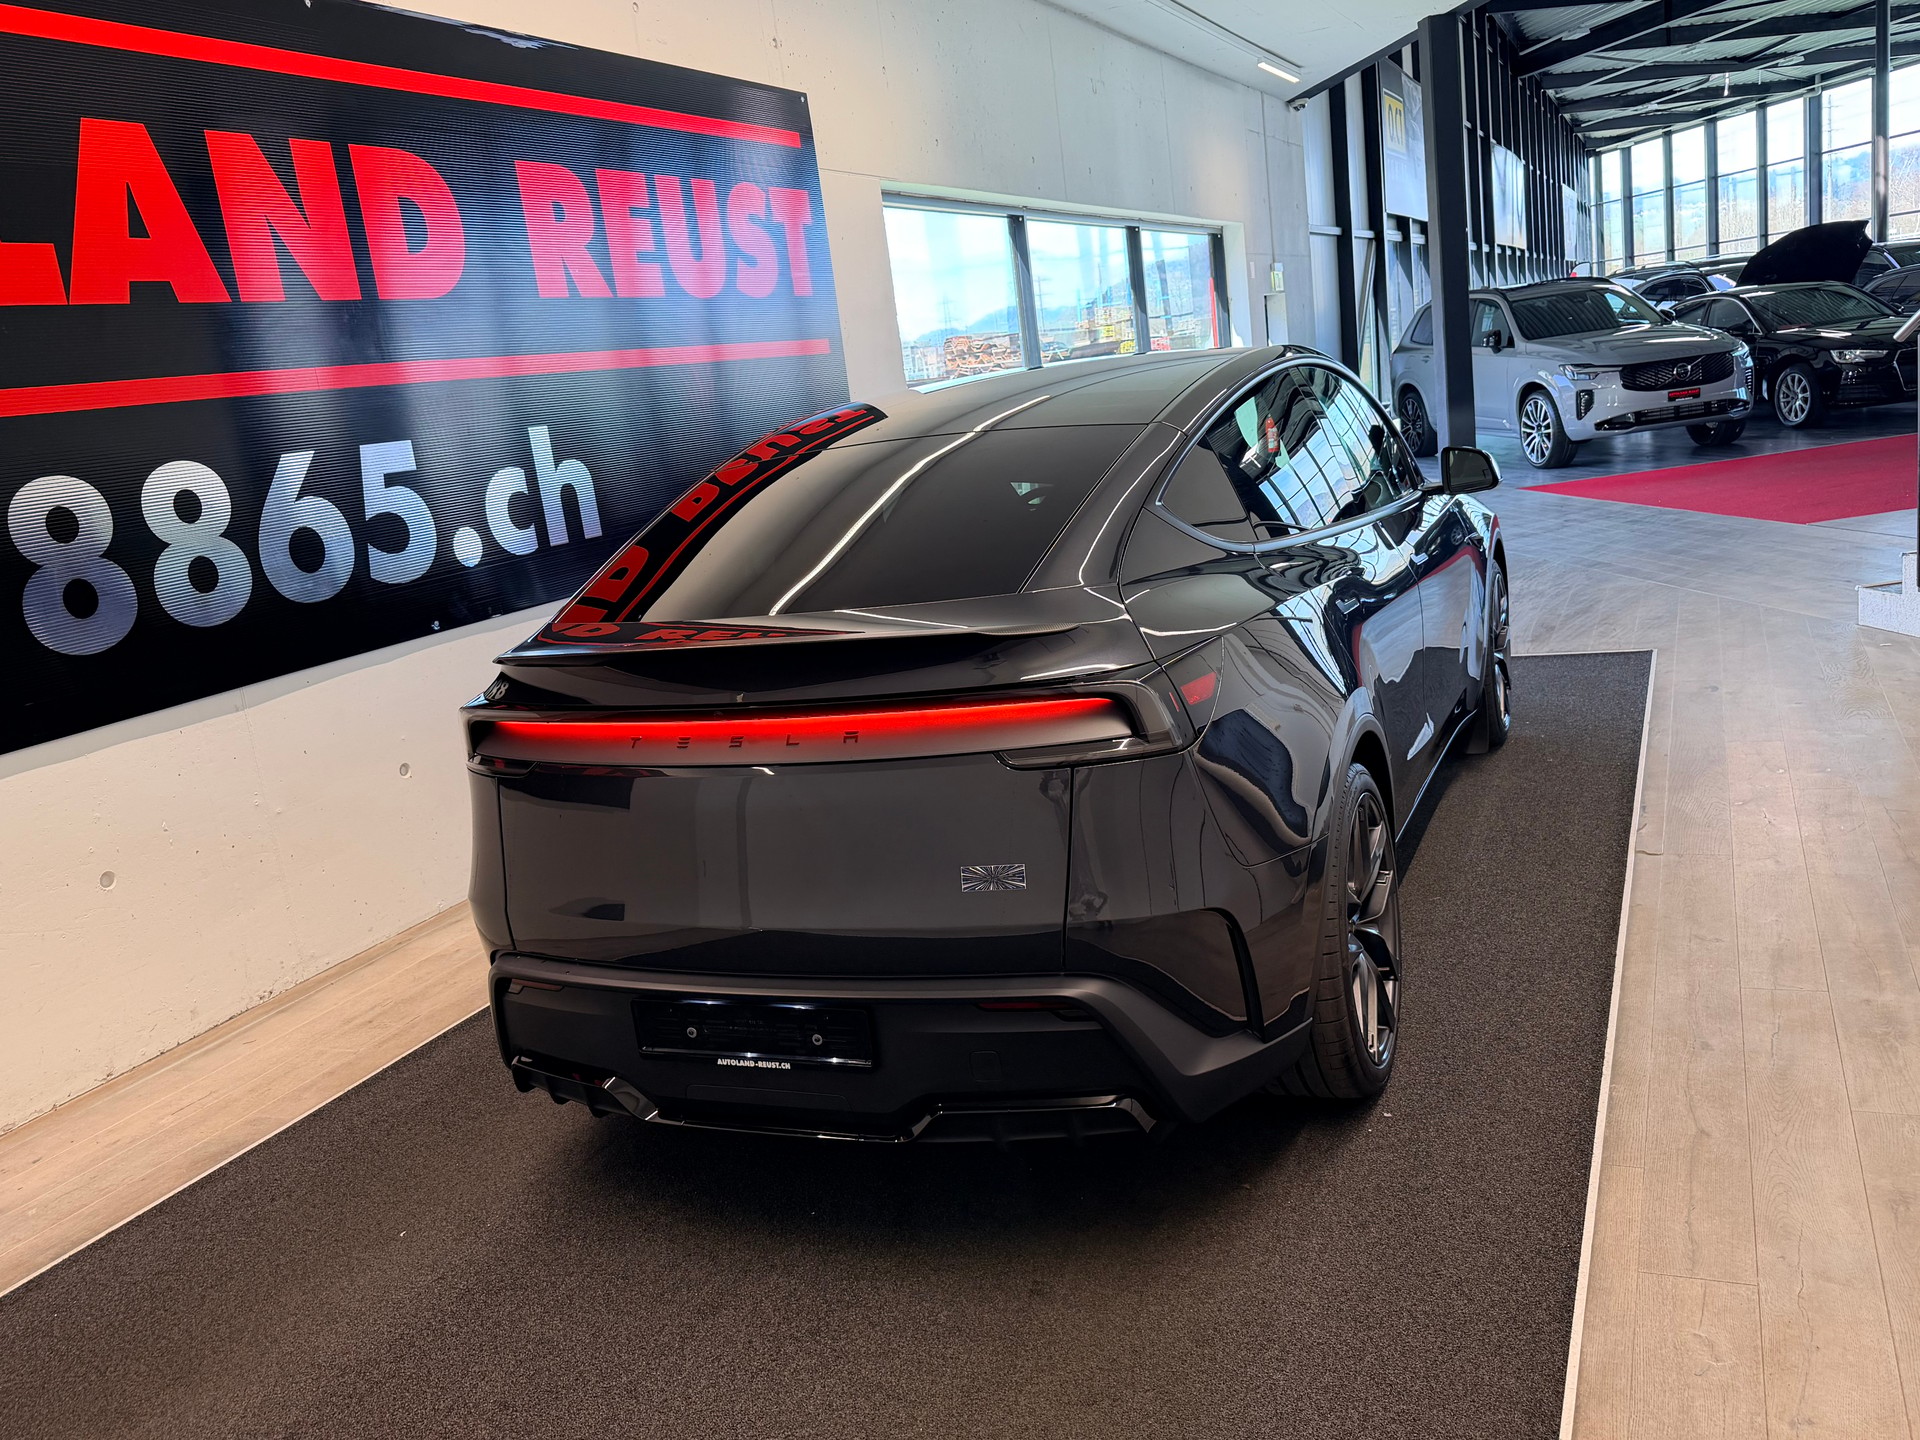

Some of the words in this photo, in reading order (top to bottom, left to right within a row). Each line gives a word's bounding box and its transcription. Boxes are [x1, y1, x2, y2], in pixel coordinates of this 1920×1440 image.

[515, 160, 812, 299] REUST
[8, 424, 602, 656] 8865.ch
[630, 730, 859, 749] TESLA
[717, 1058, 791, 1069] AUTOLAND-REUST.CH
